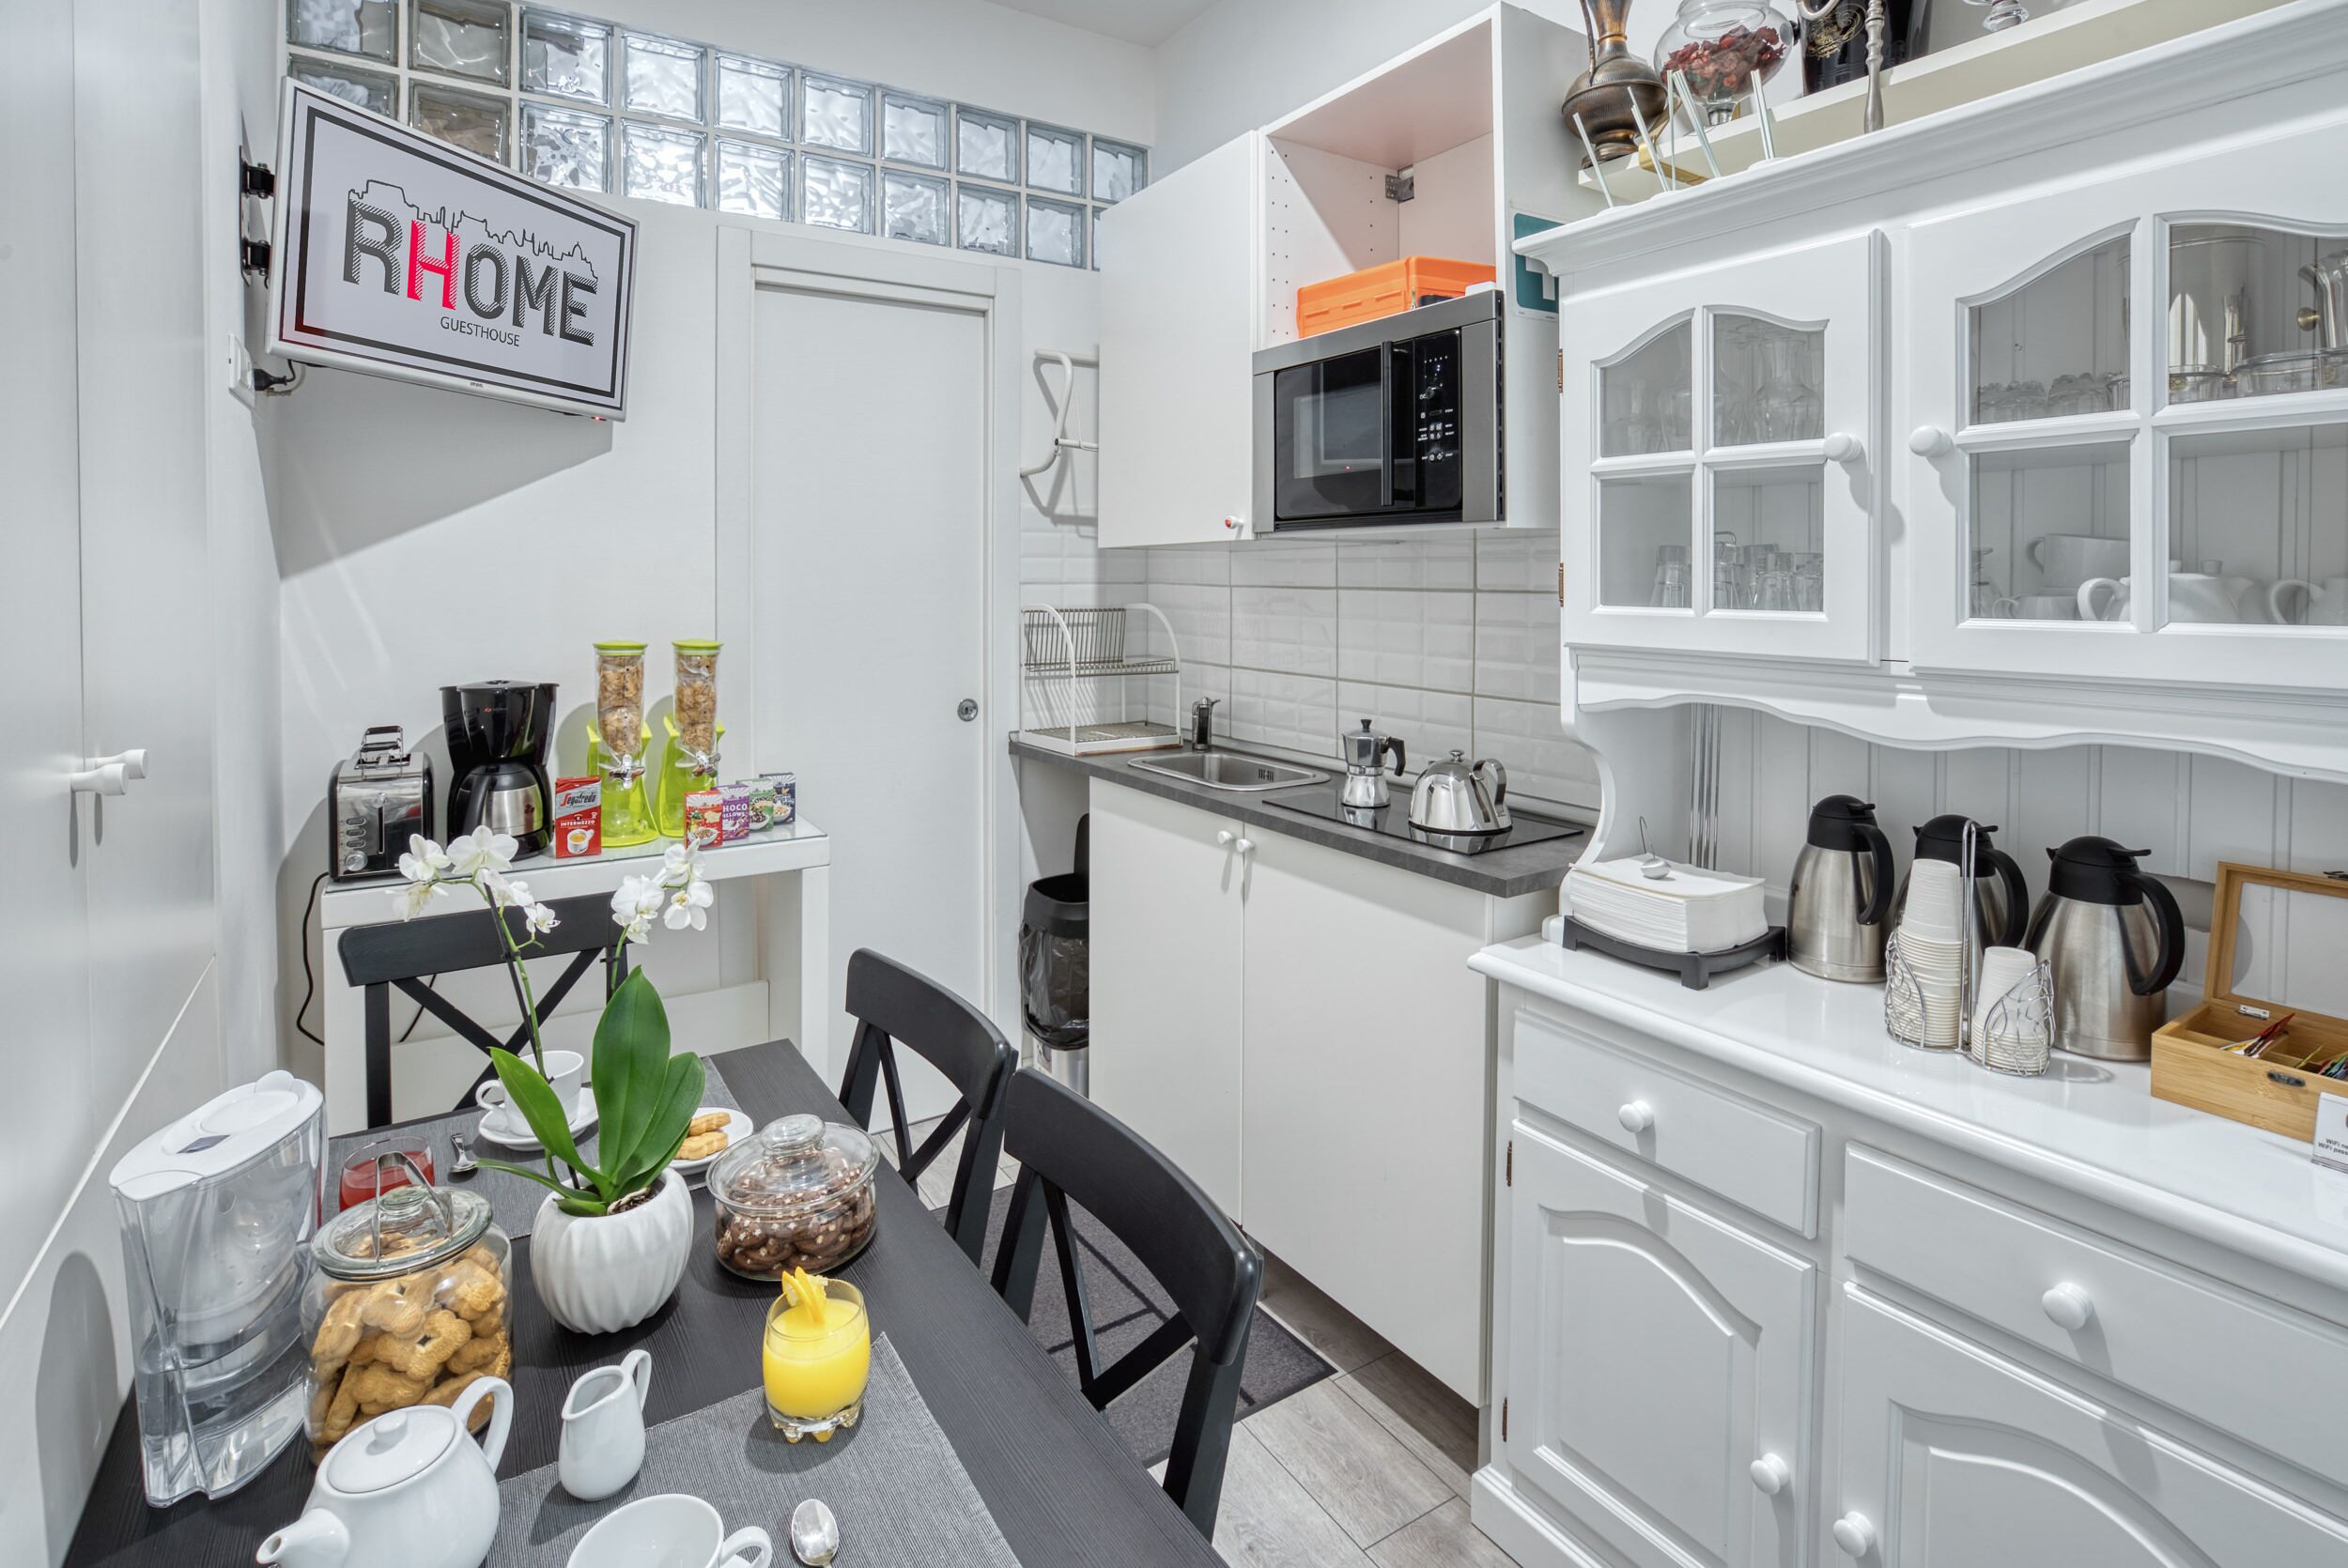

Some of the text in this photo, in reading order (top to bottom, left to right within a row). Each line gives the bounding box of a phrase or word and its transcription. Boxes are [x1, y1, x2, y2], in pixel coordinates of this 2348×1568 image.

[344, 198, 600, 347] RHOME
[440, 316, 520, 347] GUESTHOUSE
[560, 792, 596, 807] Segafredo
[722, 803, 748, 813] HOCO
[722, 810, 745, 819] ILLOWS
